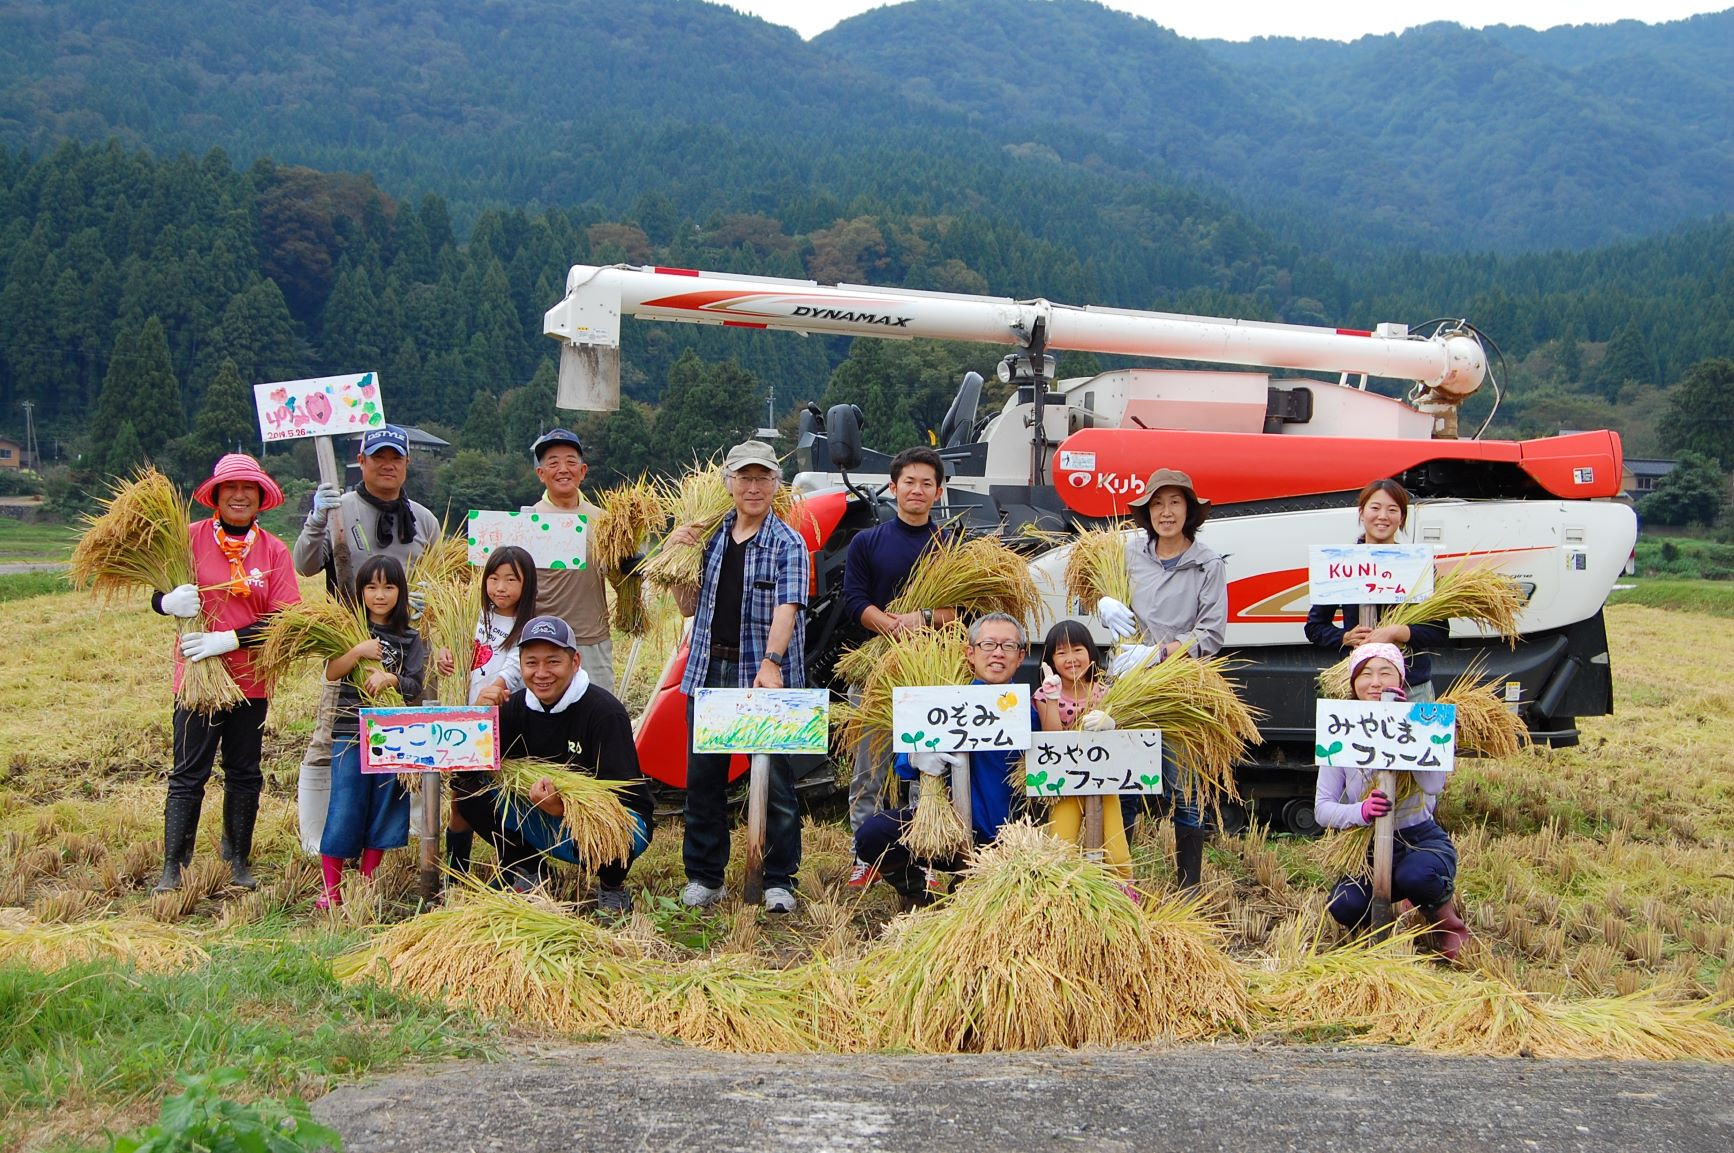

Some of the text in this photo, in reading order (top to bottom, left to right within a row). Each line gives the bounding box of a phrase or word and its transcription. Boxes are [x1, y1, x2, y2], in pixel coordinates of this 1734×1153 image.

[792, 306, 915, 327] DYNAMAX
[1097, 472, 1146, 494] Kub
[1329, 563, 1392, 579] KUNIの
[1365, 583, 1406, 594] ファーム
[927, 702, 1000, 727] のぞみ
[382, 723, 467, 751] ここりの
[1328, 712, 1416, 744] みやじま
[948, 729, 1013, 750] ファーム
[436, 750, 479, 765] ファーム
[1037, 742, 1110, 765] あやの
[1352, 743, 1440, 767] ファーム
[1065, 769, 1143, 790] ファーム
